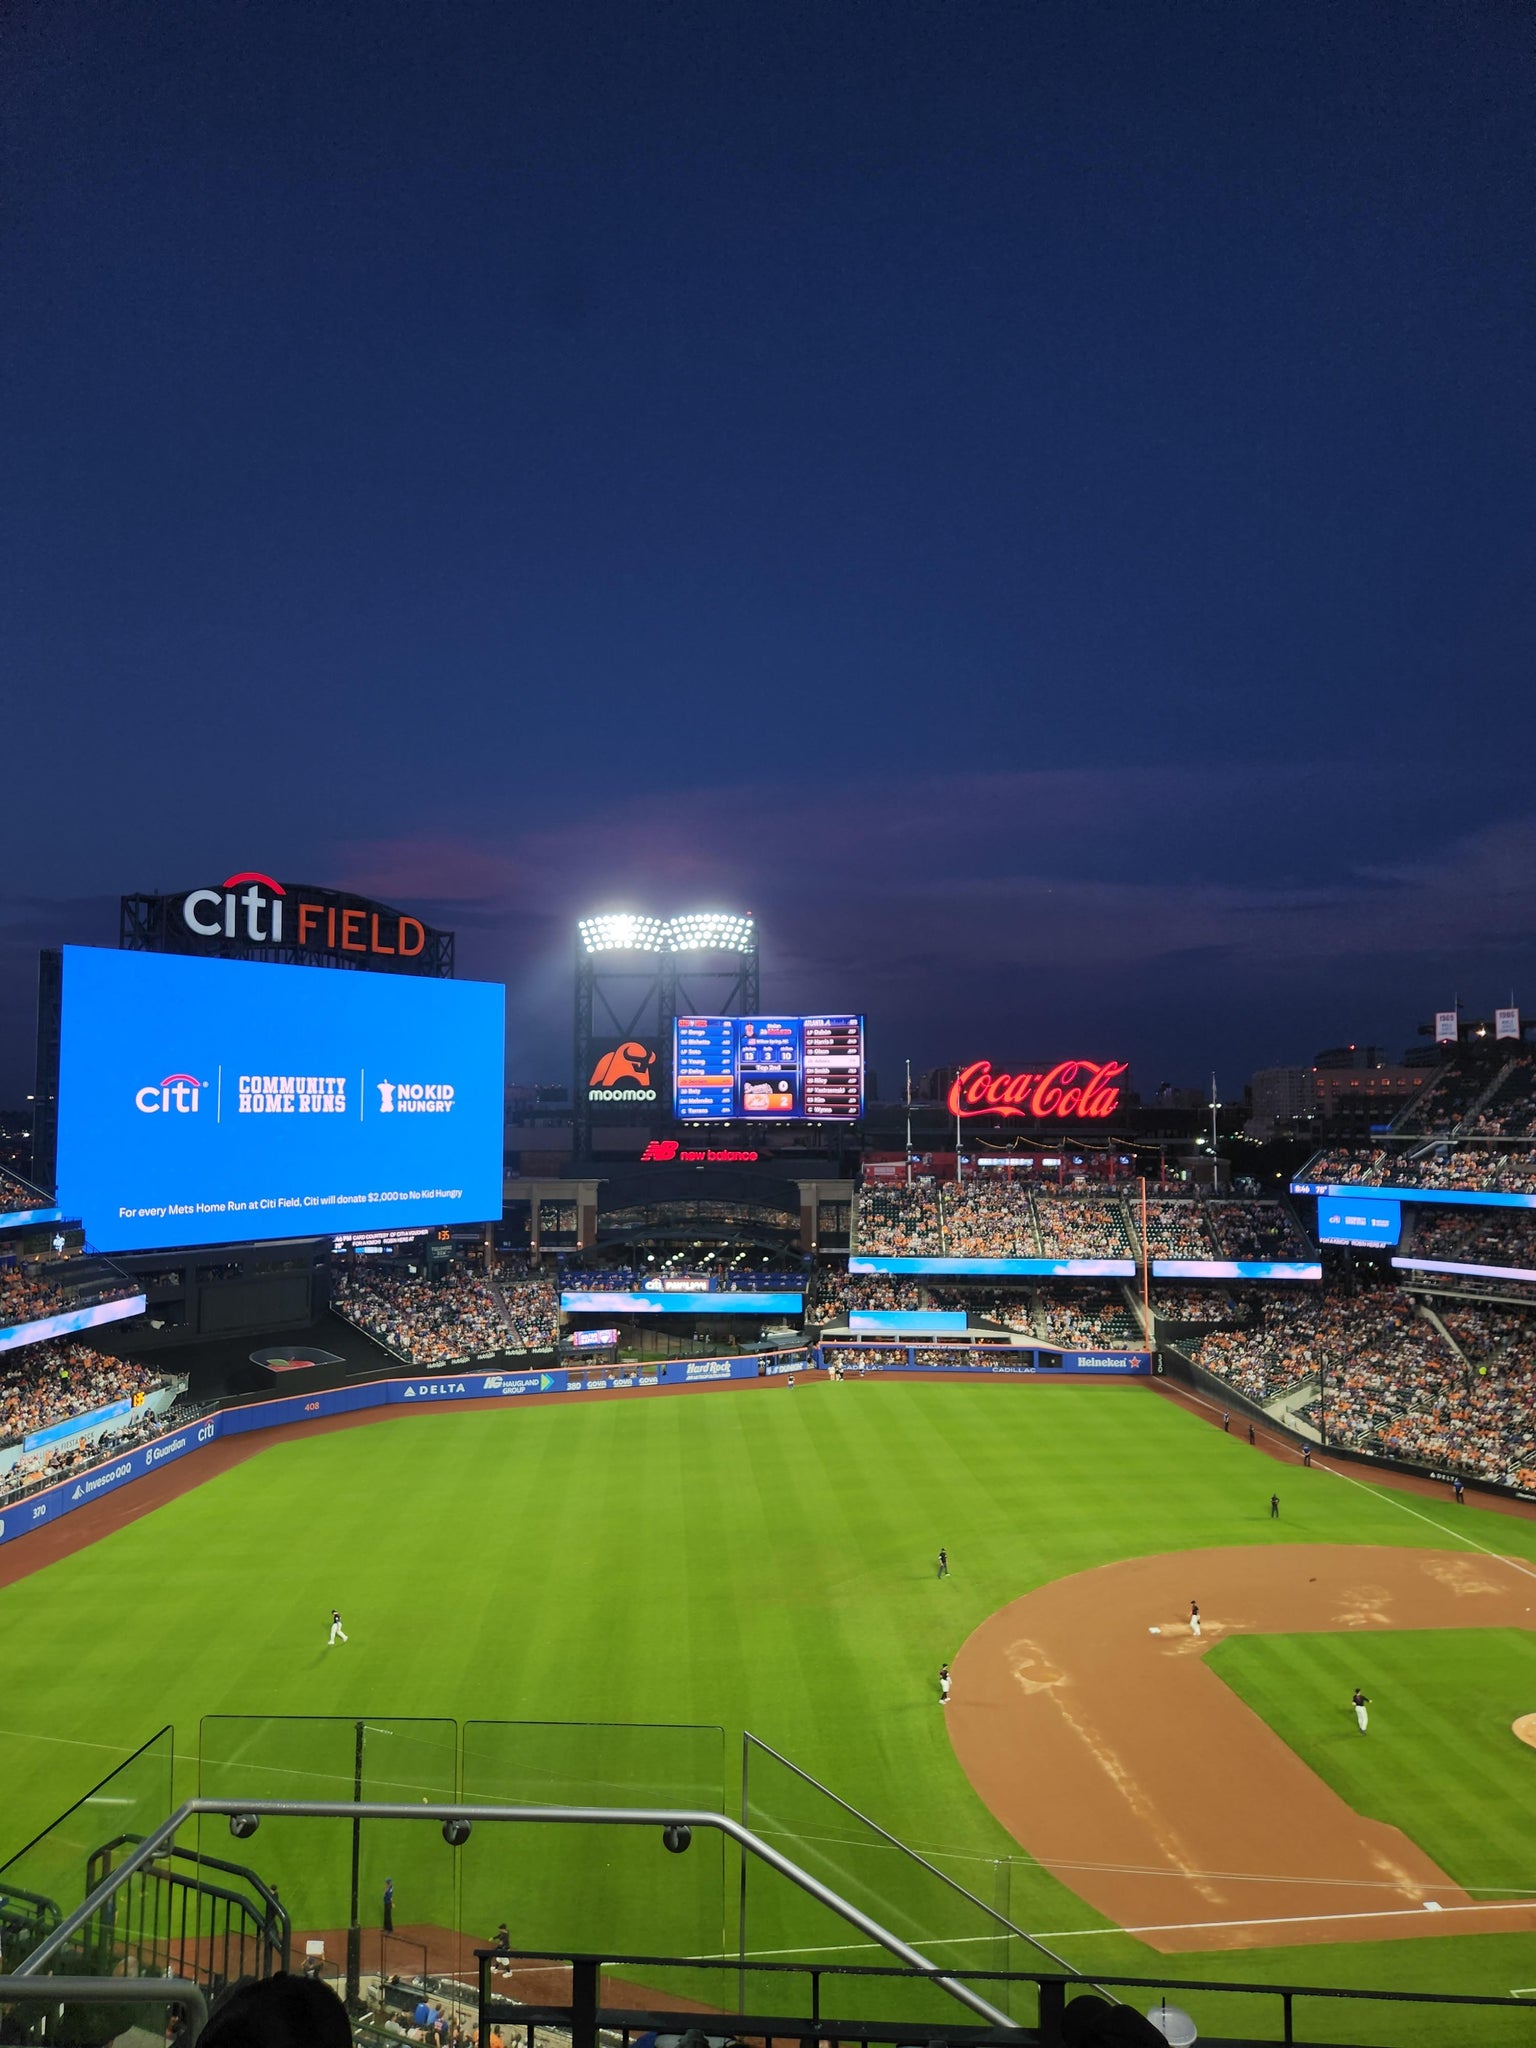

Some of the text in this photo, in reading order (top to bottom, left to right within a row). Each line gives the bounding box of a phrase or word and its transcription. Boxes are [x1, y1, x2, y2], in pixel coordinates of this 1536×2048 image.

[183, 877, 426, 956] citi FIELD
[745, 1052, 754, 1060] 13
[765, 1052, 771, 1060] 3
[782, 1052, 792, 1060] 10
[239, 1075, 346, 1094] COMMUNITY
[948, 1060, 1128, 1118] Coca-Cola
[136, 1077, 199, 1113] citi
[397, 1084, 455, 1100] NO KID
[588, 1089, 656, 1101] moomoo
[239, 1094, 346, 1112] HOME RUNS
[397, 1100, 453, 1112] HUNGRY
[780, 1097, 788, 1106] 2
[680, 1151, 705, 1161] new
[707, 1149, 758, 1162] balance
[119, 1189, 462, 1218] For every Mets Home Run at Citi Field, Citi will donate $2,000 to No Kid Hungry
[687, 1361, 731, 1374] Hard Rock
[1078, 1357, 1126, 1367] Heineken
[419, 1383, 465, 1395] DELTA
[503, 1379, 539, 1388] HAUGLAND
[566, 1382, 581, 1390] 380
[502, 1386, 525, 1394] GROUP
[304, 1402, 320, 1411] 408
[198, 1422, 214, 1442] citi
[61, 1439, 79, 1450] FIESTA
[154, 1438, 186, 1460] Guardian
[85, 1462, 132, 1494] Invesco QQQ
[33, 1504, 46, 1519] 370
